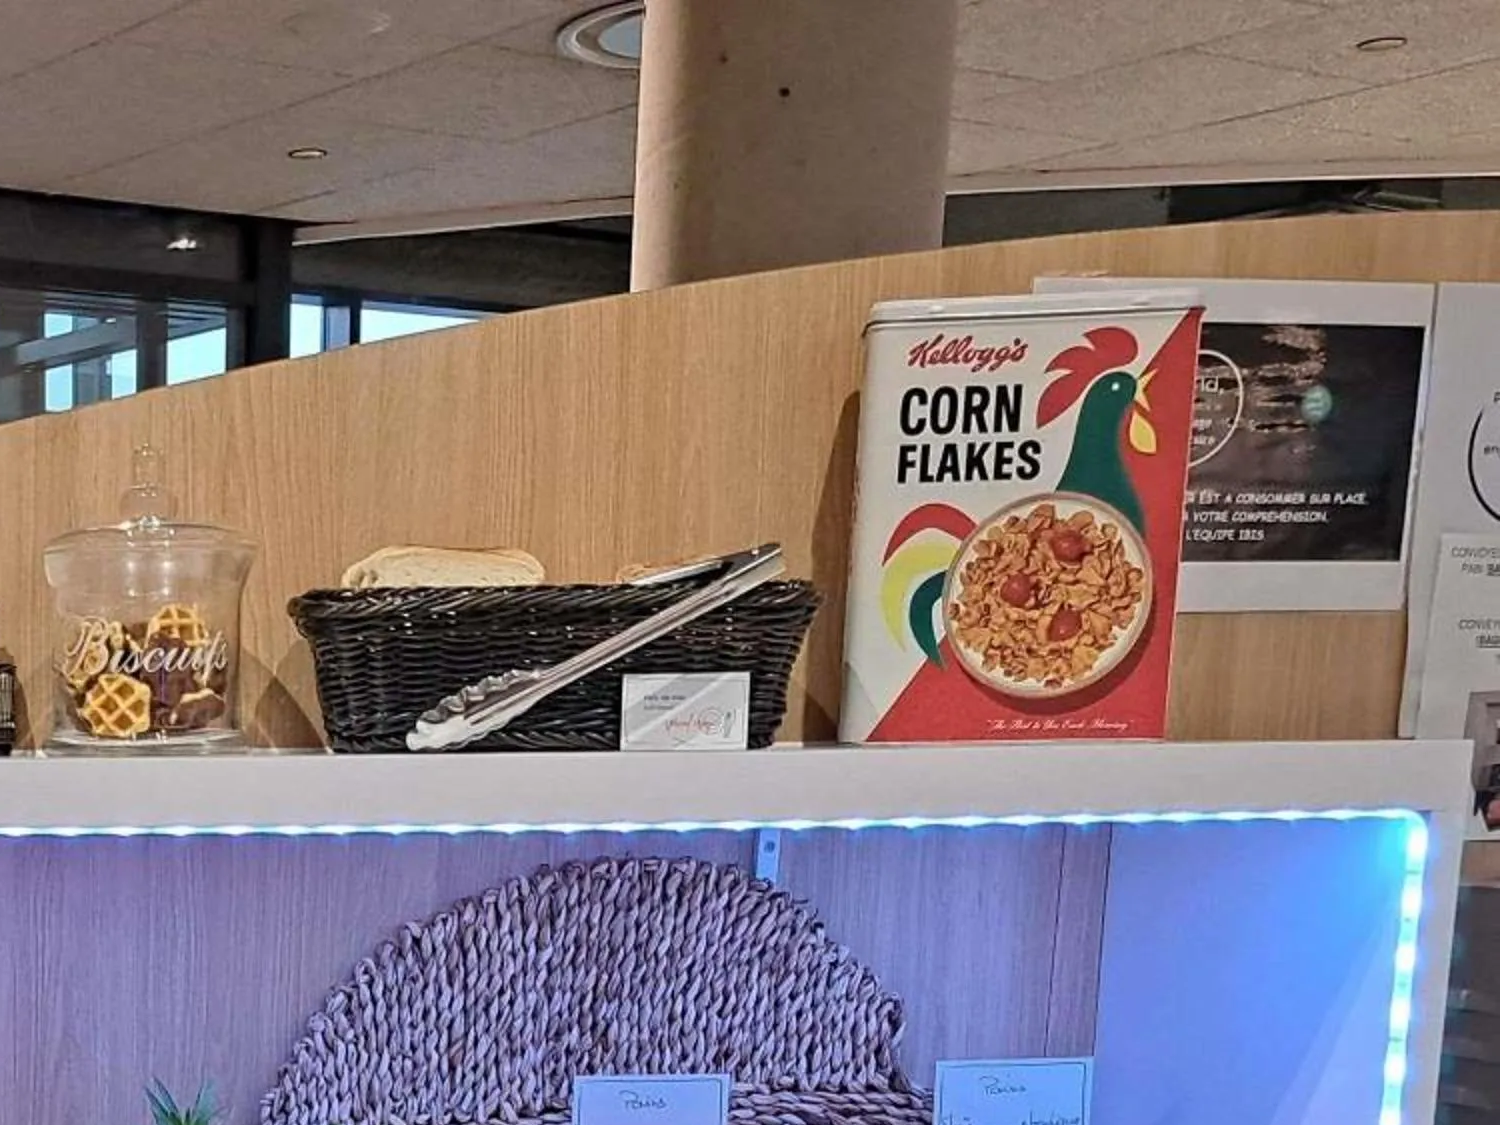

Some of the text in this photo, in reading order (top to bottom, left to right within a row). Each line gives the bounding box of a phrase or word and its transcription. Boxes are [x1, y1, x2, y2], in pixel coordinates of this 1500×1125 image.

[907, 333, 1029, 373] Kellogg's
[900, 383, 1024, 436] CORN
[897, 439, 1042, 484] FLAKES
[1193, 511, 1229, 523] VOTRE
[1309, 493, 1330, 504] SUR
[1238, 529, 1265, 541] IBIS
[54, 615, 228, 687] Biscuits
